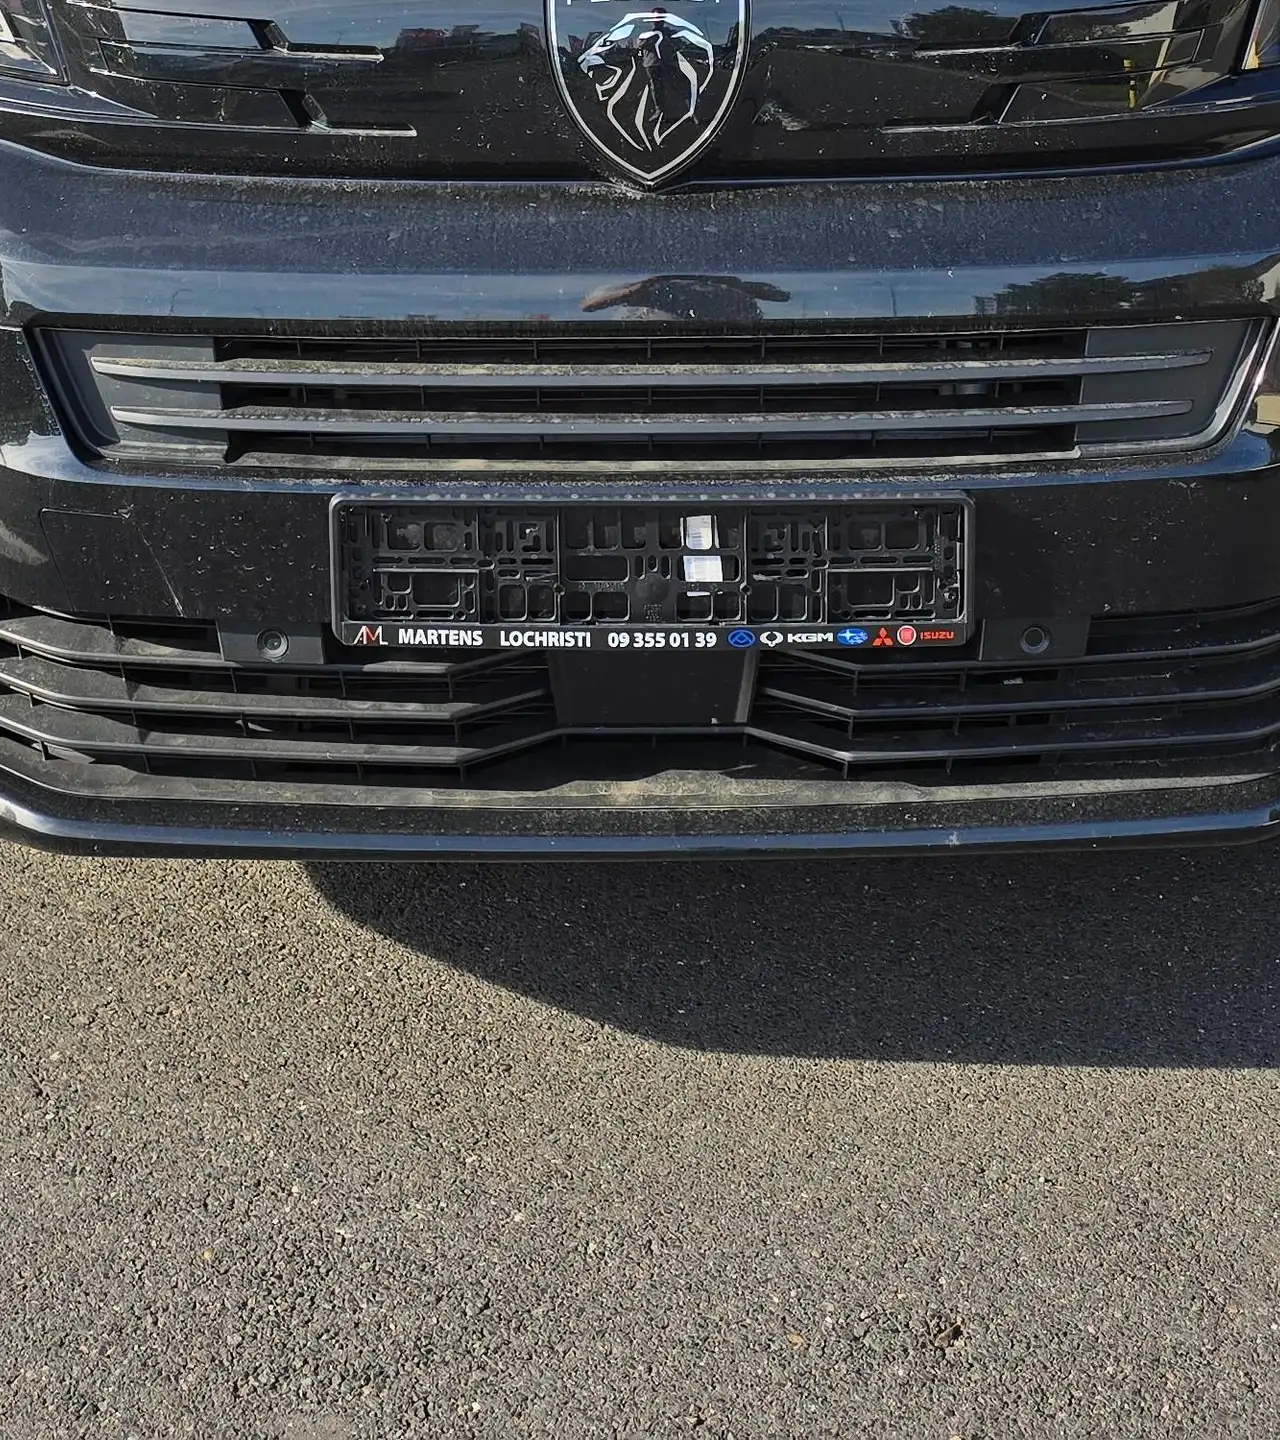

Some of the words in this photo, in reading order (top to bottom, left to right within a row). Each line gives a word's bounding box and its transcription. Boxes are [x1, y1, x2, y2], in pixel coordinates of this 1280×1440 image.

[398, 629, 483, 647] MARTENS
[500, 630, 591, 648] LOCHRISTI
[607, 632, 630, 648] 09
[633, 632, 666, 648] 355
[669, 632, 690, 648] 01
[694, 632, 718, 648] 39
[787, 632, 834, 643] KGM
[920, 630, 955, 640] ISUZU
